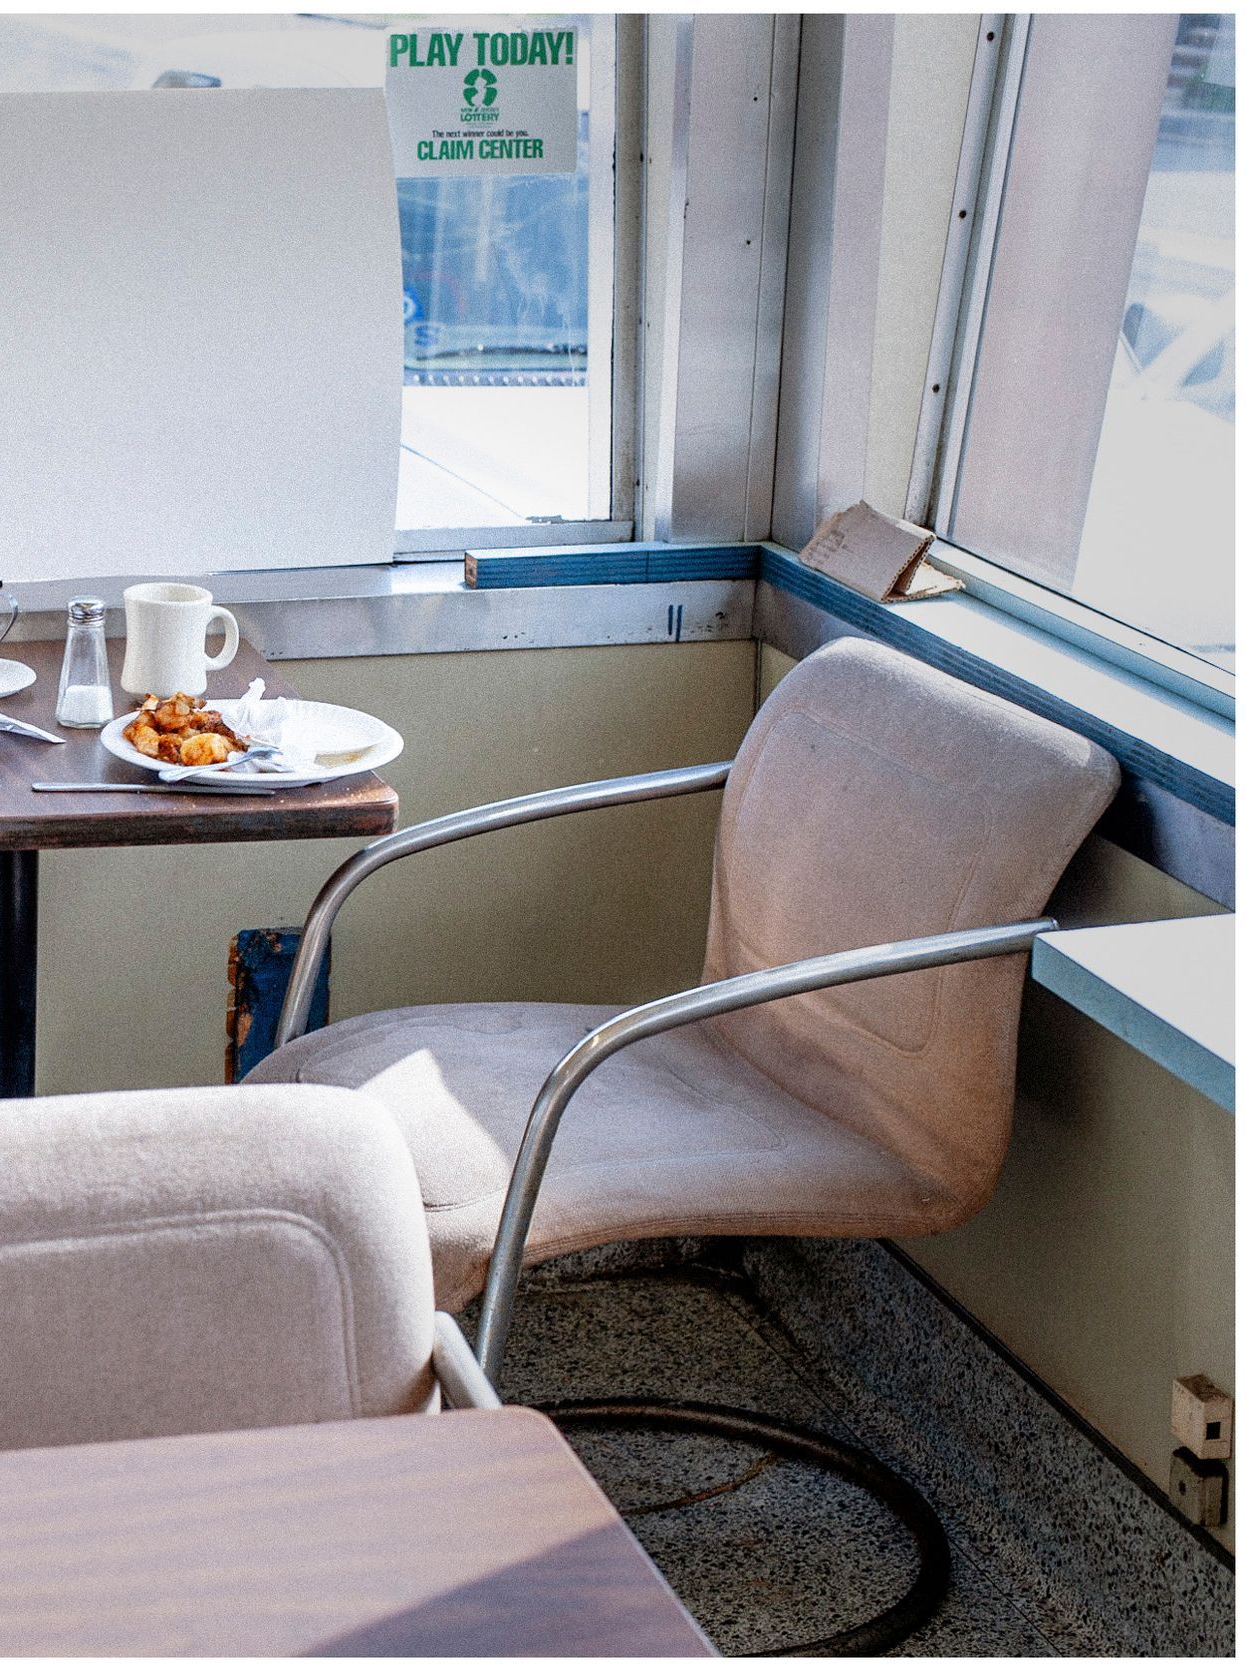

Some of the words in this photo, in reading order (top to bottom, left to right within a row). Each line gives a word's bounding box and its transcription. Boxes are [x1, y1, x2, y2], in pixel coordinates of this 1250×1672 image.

[390, 33, 464, 68] PLAY
[473, 32, 574, 66] TODAY!
[460, 112, 500, 122] LOTTERY
[486, 129, 504, 137] could
[515, 130, 529, 138] you.
[417, 140, 474, 161] CLAIM
[479, 138, 543, 160] CENTER
